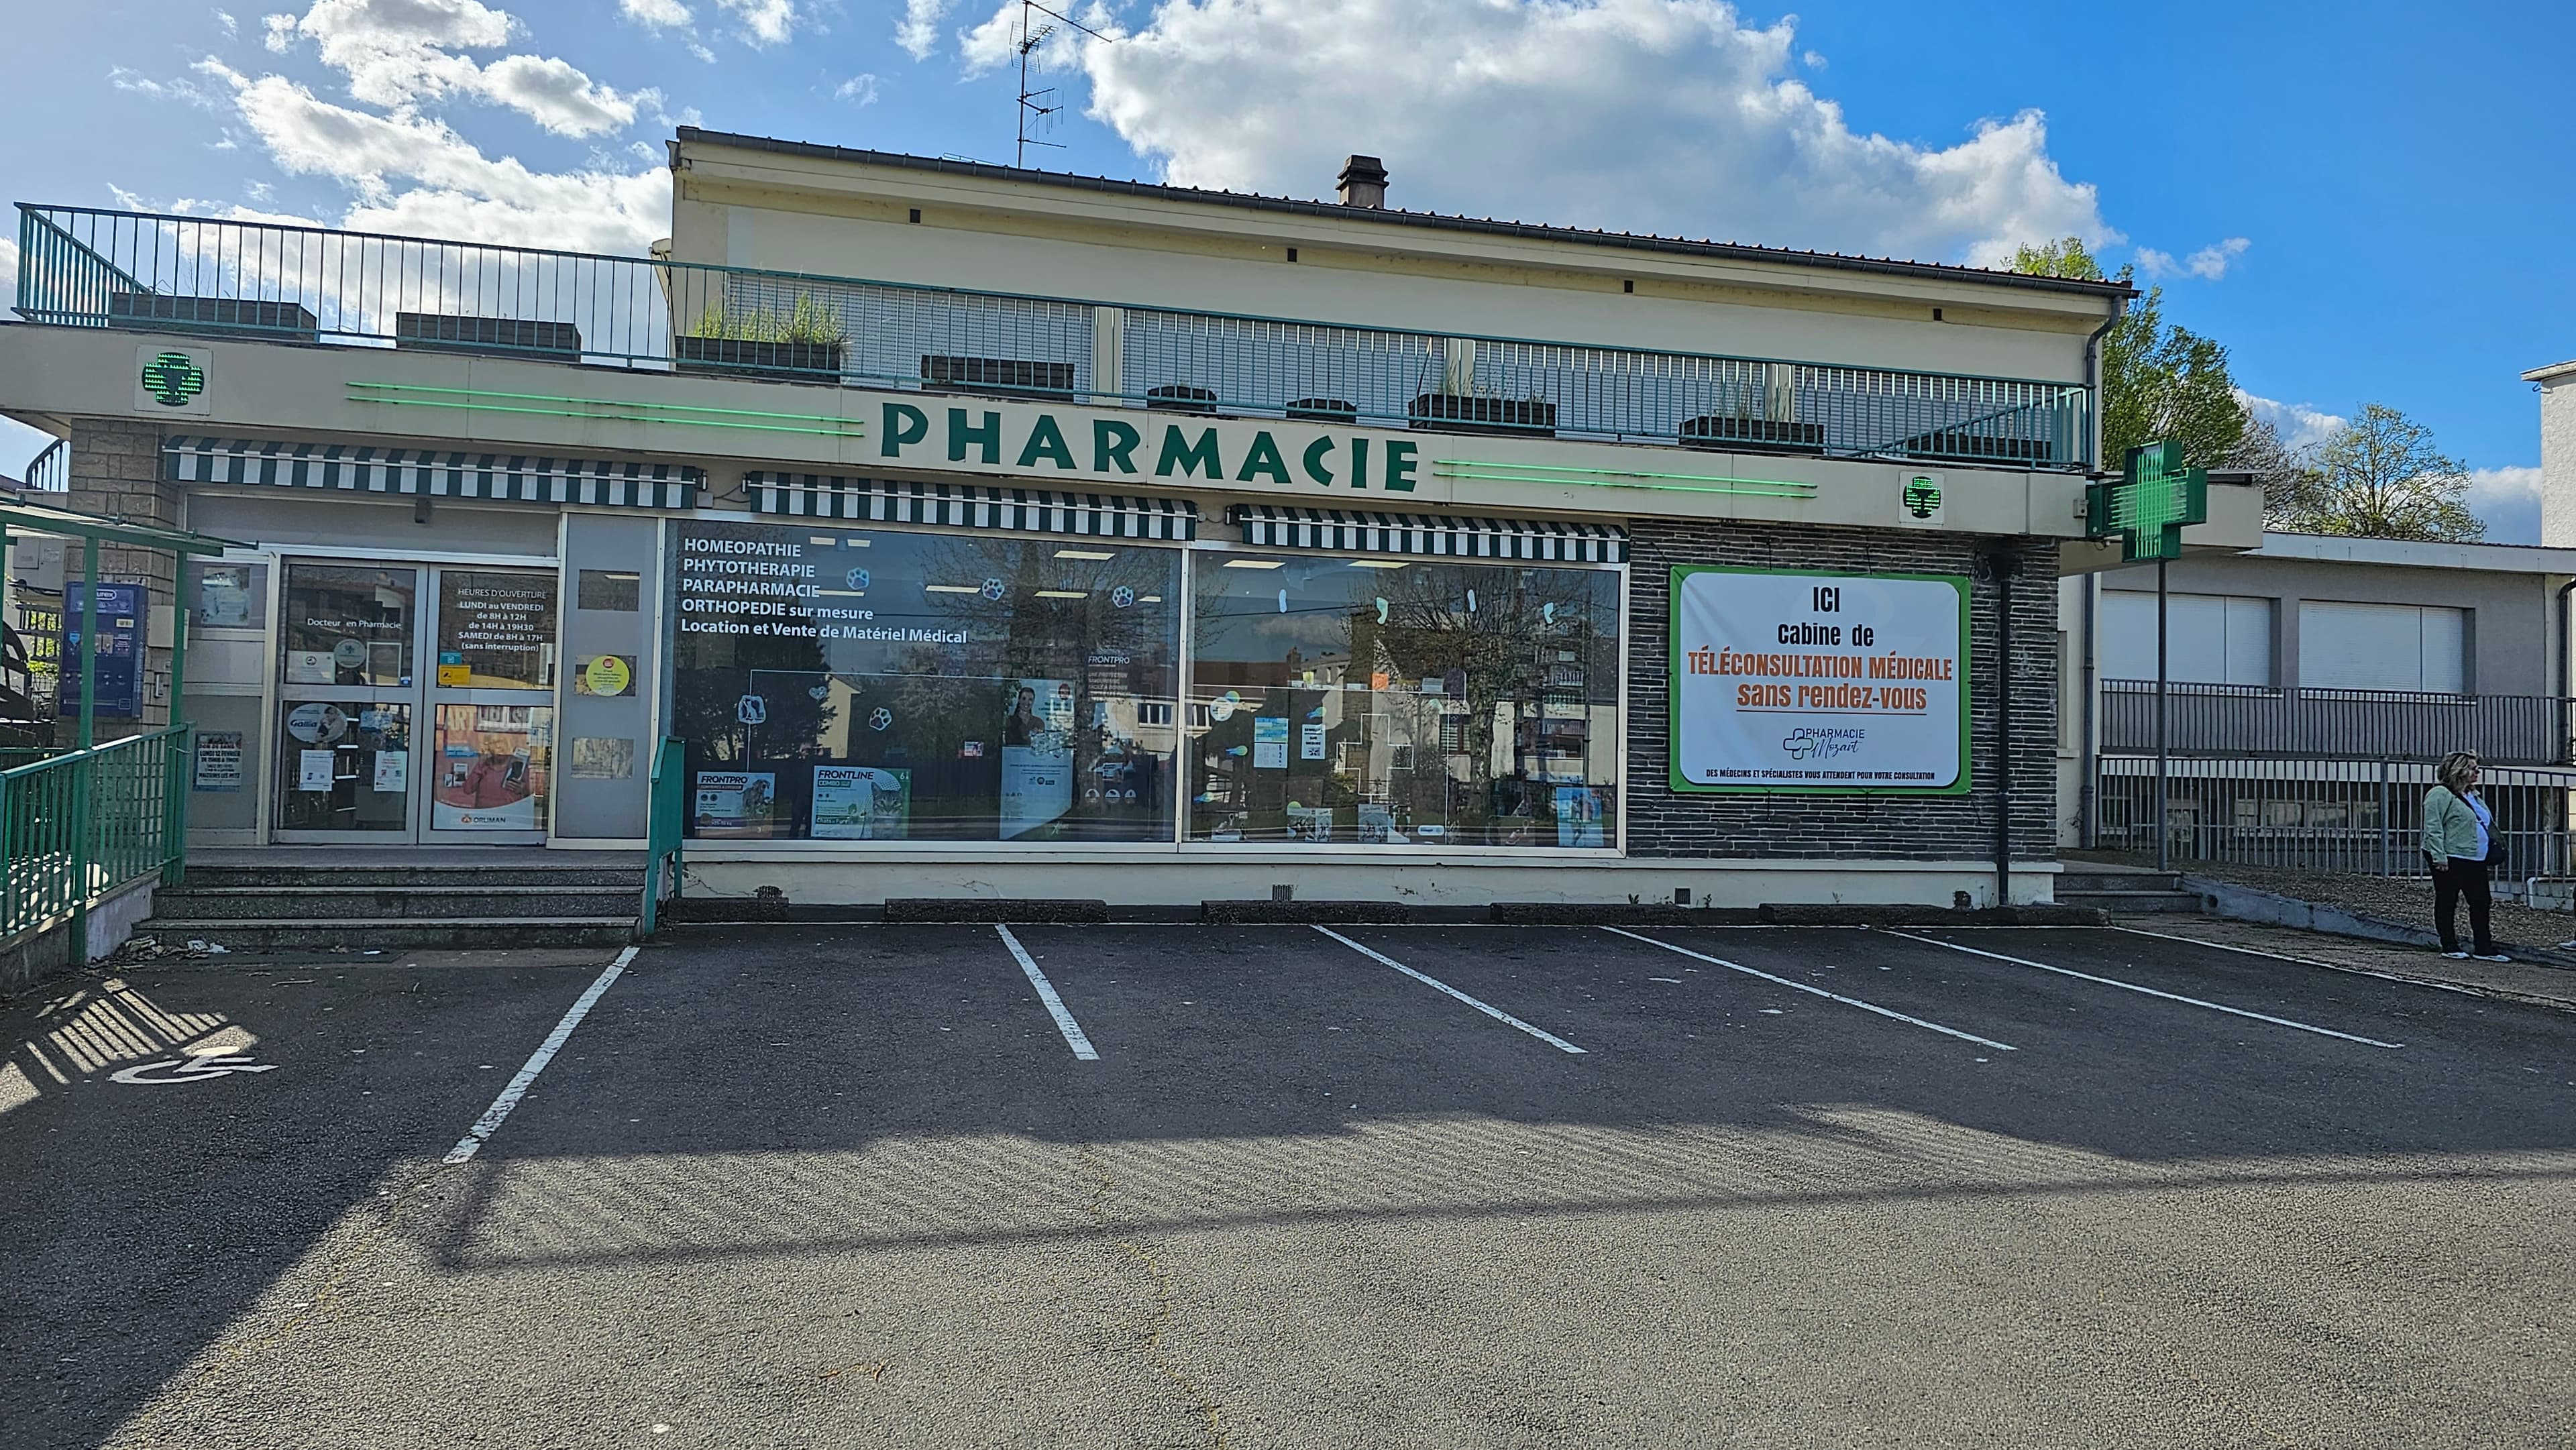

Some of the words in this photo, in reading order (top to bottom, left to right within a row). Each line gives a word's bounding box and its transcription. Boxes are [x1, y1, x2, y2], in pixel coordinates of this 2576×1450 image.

[881, 402, 1418, 492] PHARMACIE
[684, 538, 801, 557] HOMEOPATHIE
[684, 558, 815, 577] PHYTOTHERAPIE
[458, 588, 490, 597] HEURES
[491, 590, 547, 599] D'OUVERTURE
[683, 578, 820, 598] PARAPHARMACIE
[460, 601, 487, 610] LUNDI
[500, 603, 543, 611] VENDREDI
[1813, 586, 1840, 612] ICI
[682, 598, 786, 616] ORTHOPEDIE
[790, 607, 813, 617] sur
[817, 608, 873, 620] mesure
[307, 618, 341, 626] Docteur
[359, 620, 402, 629] Pharmacie
[682, 618, 749, 634] Location
[753, 622, 769, 635] et
[772, 622, 816, 637] Vente
[820, 625, 839, 638] de
[843, 626, 905, 640] Matériel
[909, 629, 967, 643] Médical
[458, 632, 492, 640] SAMEDI
[1778, 622, 1841, 646] cabine
[1852, 624, 1874, 647] de
[485, 643, 539, 652] interruption)
[1088, 656, 1130, 664] FRONTPRO
[1688, 645, 1862, 679] TÉLÉCONSULTATION
[1869, 651, 1952, 681] MÉDICALE
[1737, 683, 1791, 708] sans
[1798, 683, 1927, 710] rendez-vous
[290, 720, 317, 728] Gallia
[1806, 728, 1865, 738] PHARMACIE
[1811, 738, 1862, 759] Mozart
[701, 775, 748, 783] FRONTPRO
[818, 770, 874, 779] FRONTLINE
[1720, 767, 1751, 778] MÉDECINS
[1762, 768, 1803, 778] SPÉCIALISTES
[1822, 771, 1856, 779] ATTENDENT
[1857, 771, 1873, 779] POUR
[1894, 772, 1935, 780] CONSULTATION
